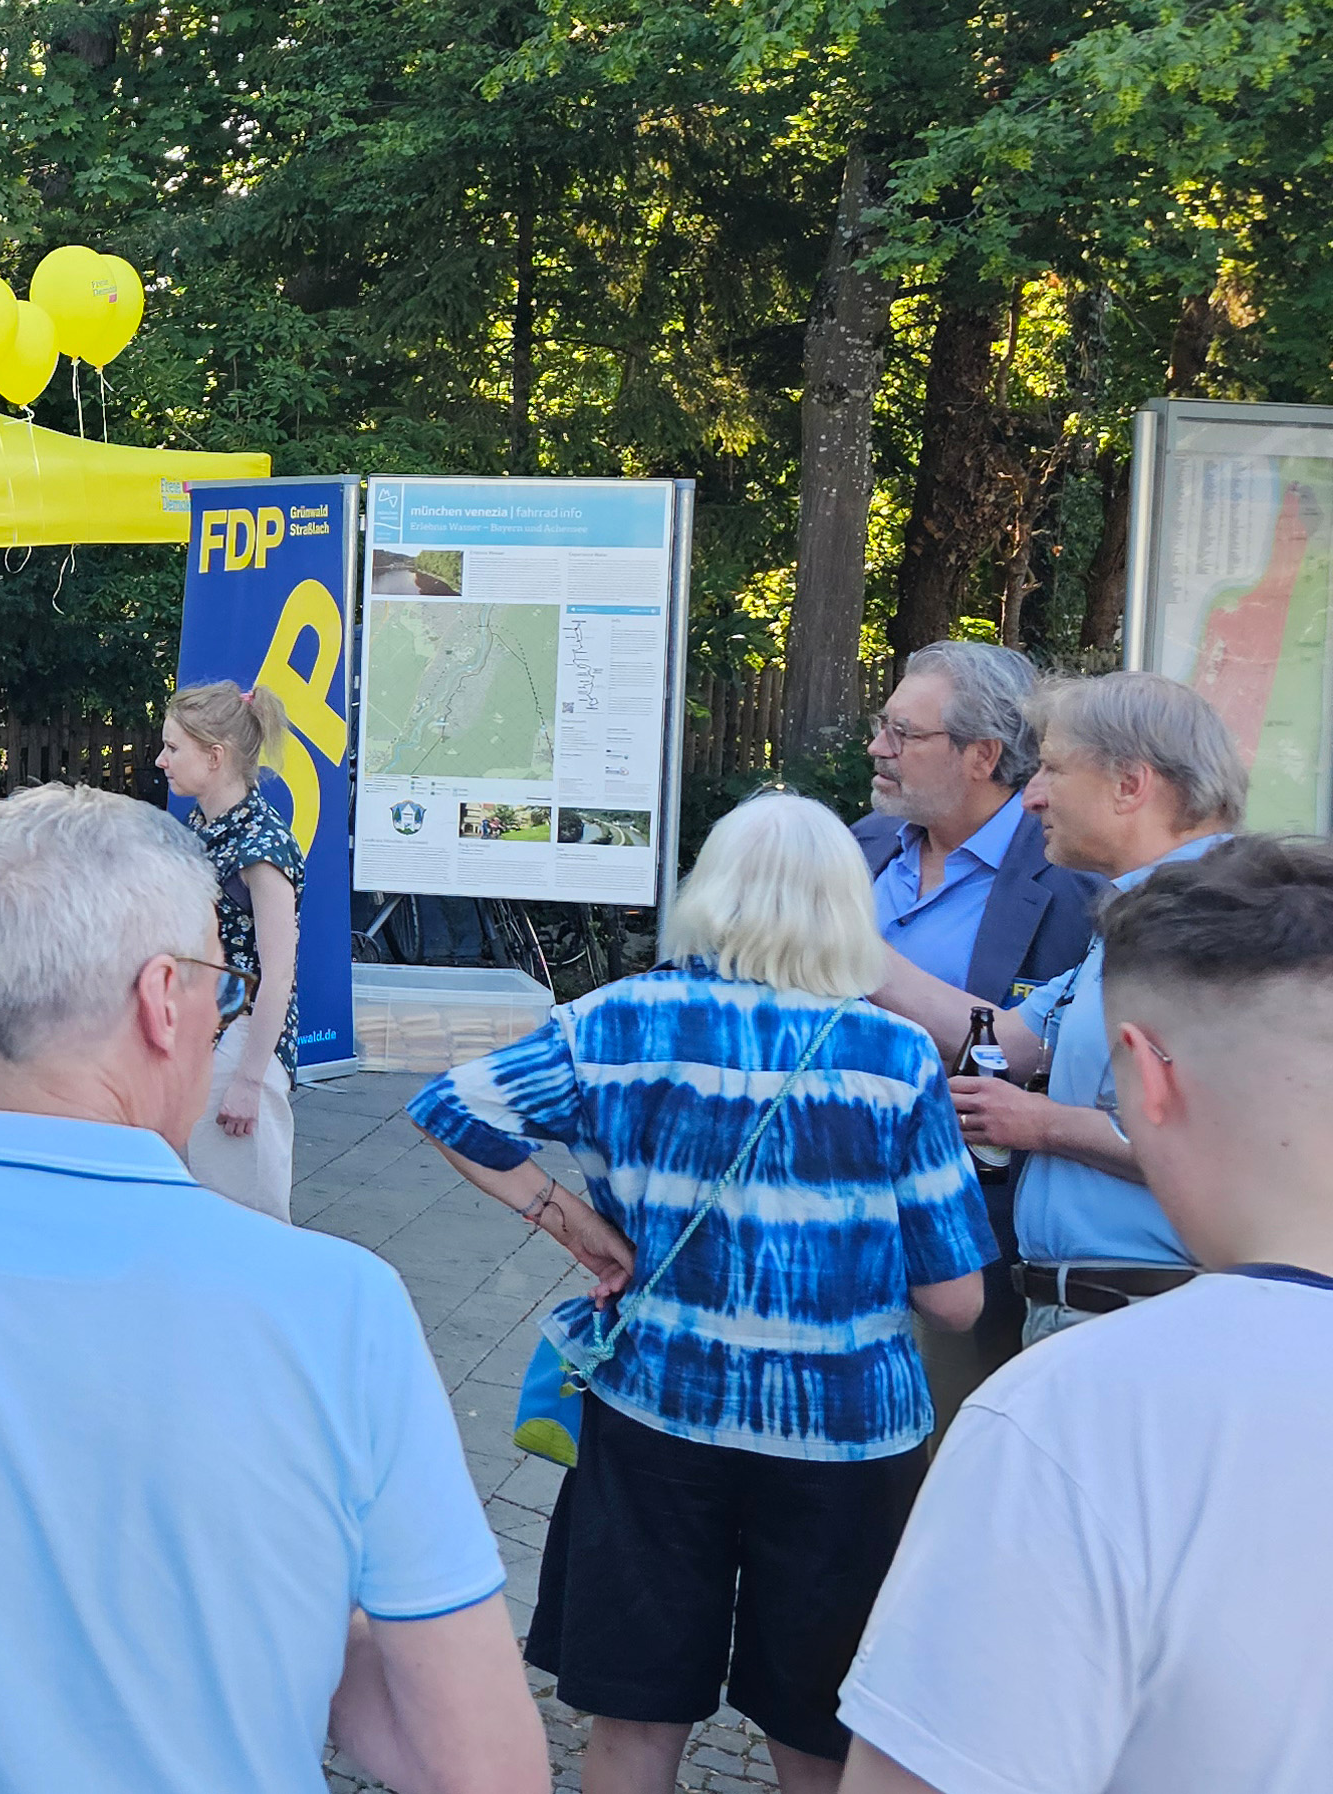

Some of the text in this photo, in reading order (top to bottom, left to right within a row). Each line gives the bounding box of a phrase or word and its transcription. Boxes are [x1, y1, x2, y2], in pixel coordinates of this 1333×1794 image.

[290, 504, 329, 519] Grünwald
[410, 505, 462, 517] münchen
[464, 507, 508, 517] venezia
[516, 506, 558, 518] fahrrad
[560, 507, 582, 519] info
[290, 521, 330, 536] Straßlach
[199, 506, 285, 573] FDP
